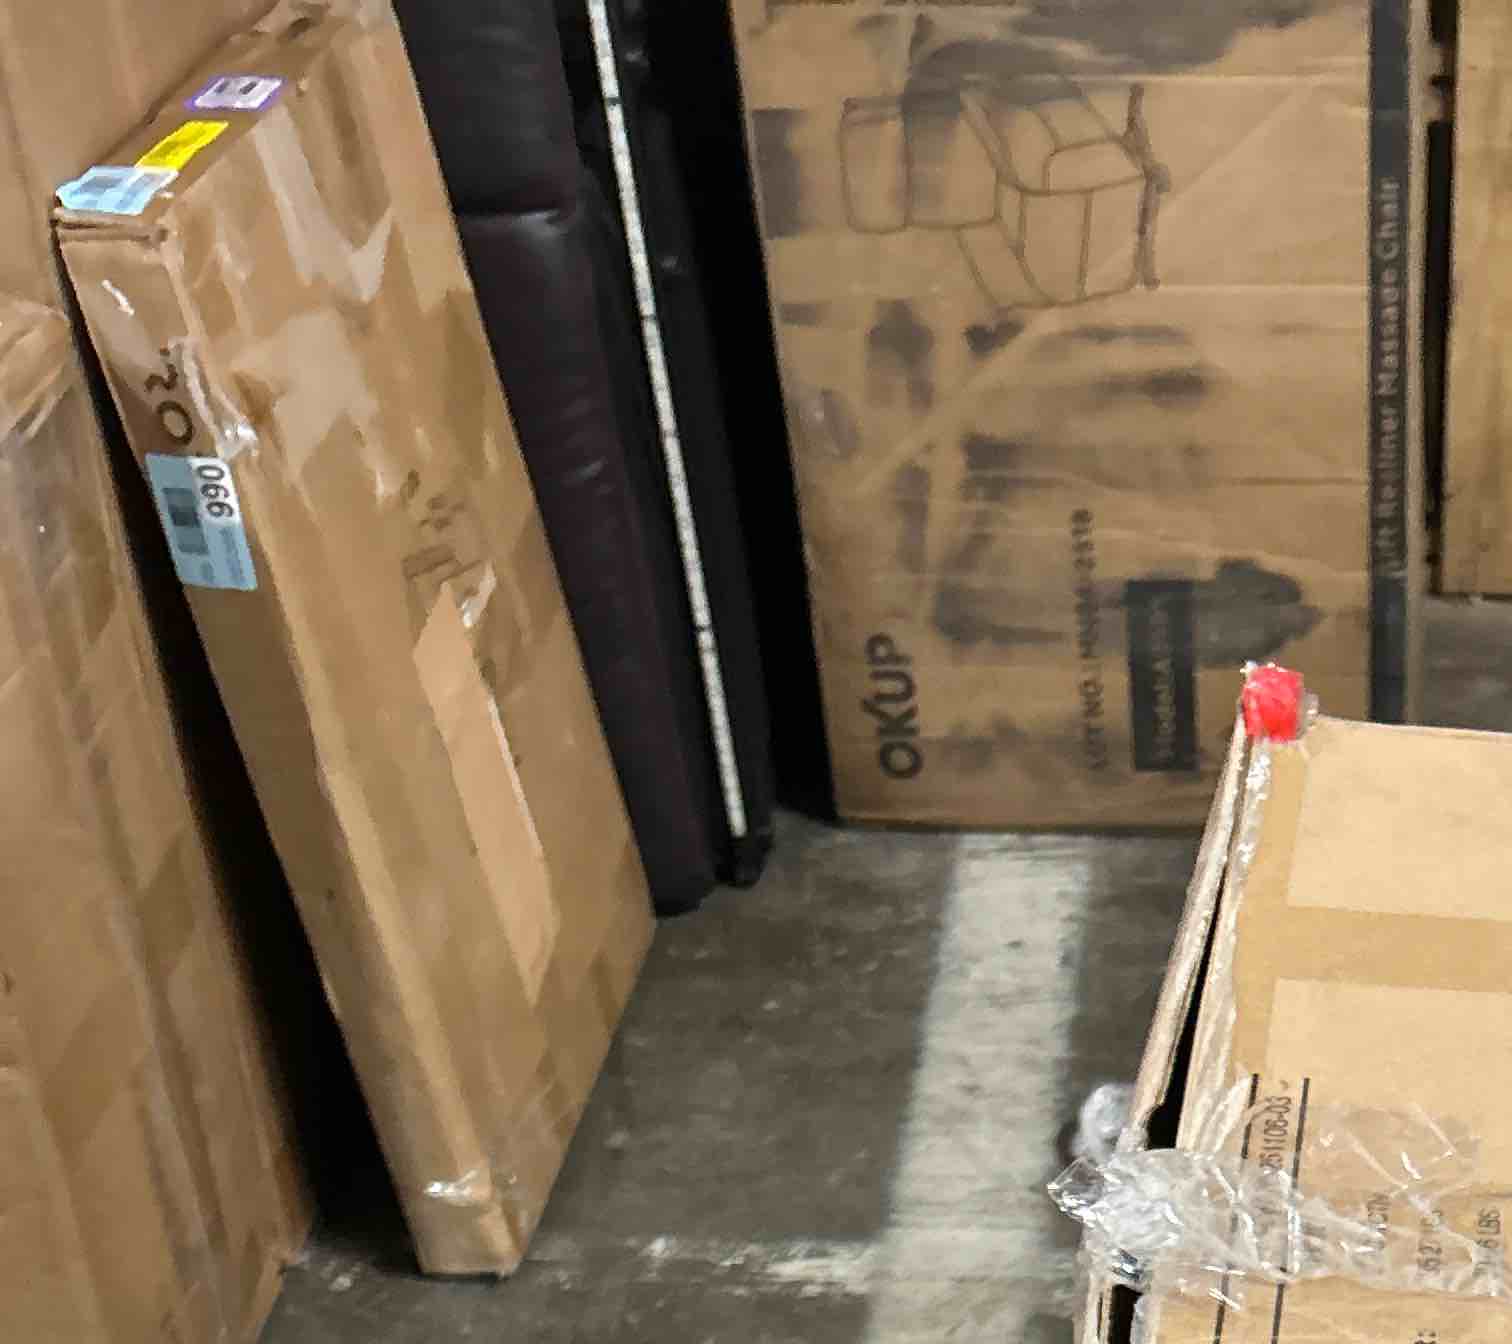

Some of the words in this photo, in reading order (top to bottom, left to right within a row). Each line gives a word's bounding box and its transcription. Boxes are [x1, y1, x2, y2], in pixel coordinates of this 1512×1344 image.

[1374, 178, 1402, 261] Chair
[1376, 268, 1404, 396] Massage
[196, 464, 236, 518] 990
[862, 633, 923, 780] OKUP
